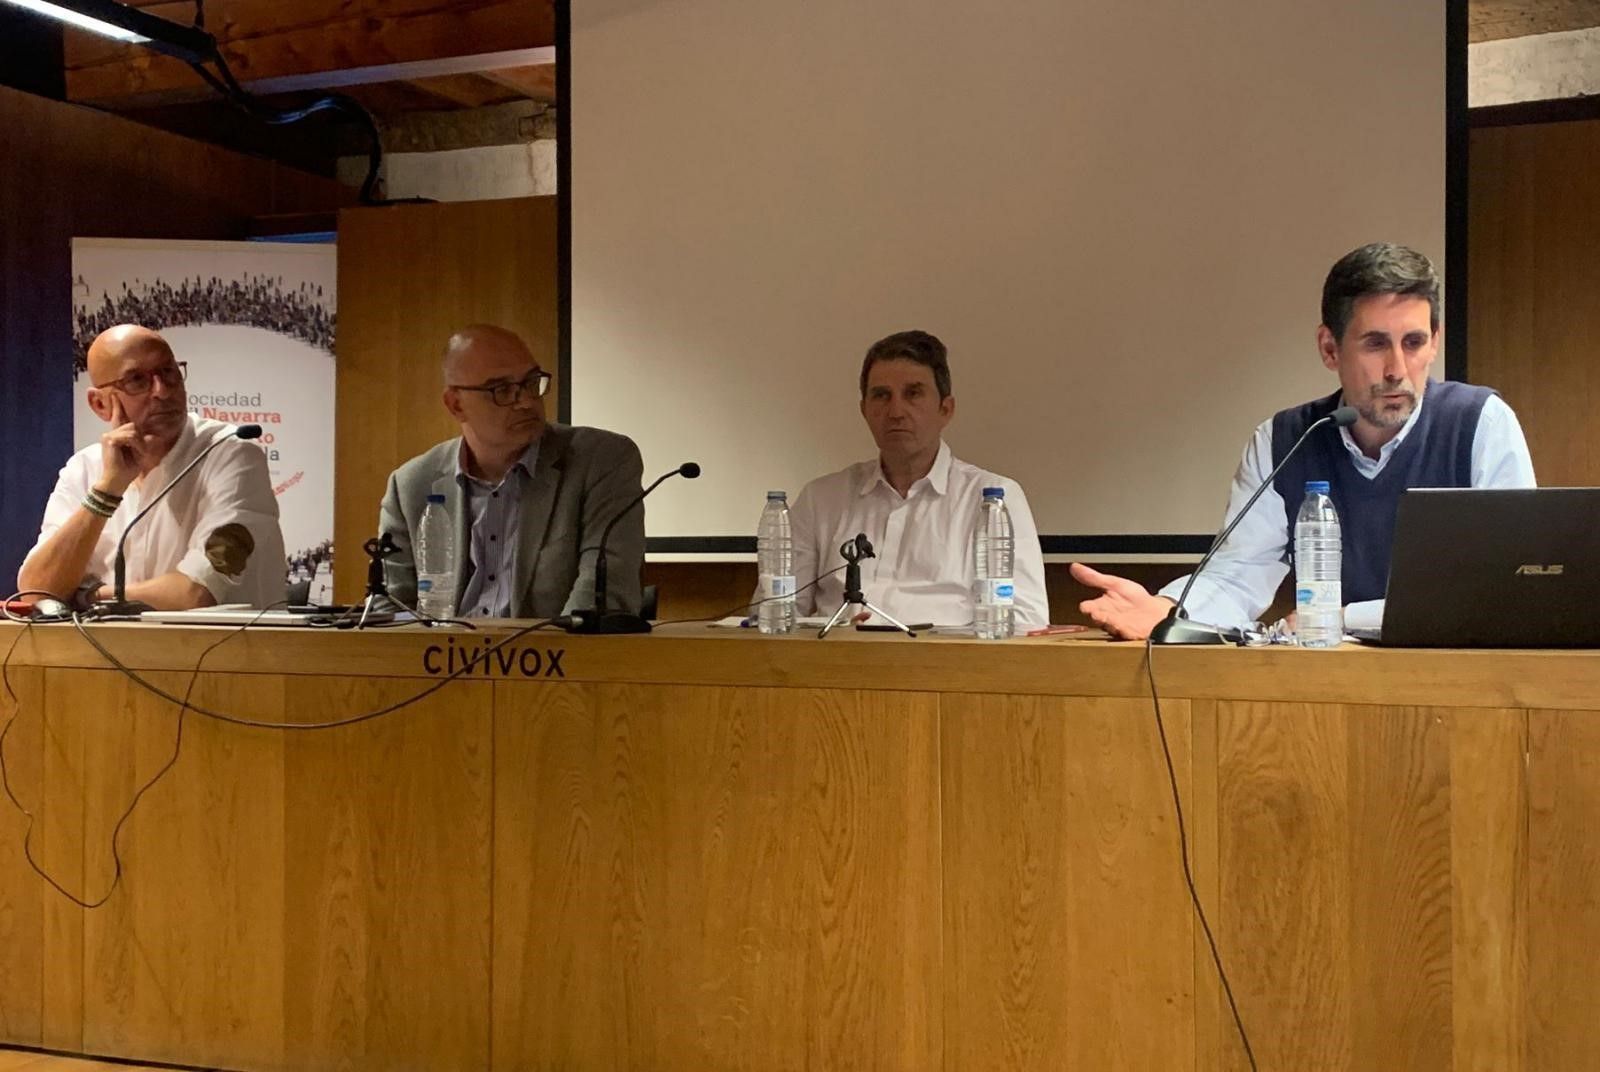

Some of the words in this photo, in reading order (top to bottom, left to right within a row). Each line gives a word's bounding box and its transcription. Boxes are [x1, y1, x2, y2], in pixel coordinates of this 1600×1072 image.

[188, 391, 262, 407] ociedad
[202, 407, 281, 424] Navarra
[1514, 564, 1564, 575] ASUS
[423, 636, 566, 678] civivox
